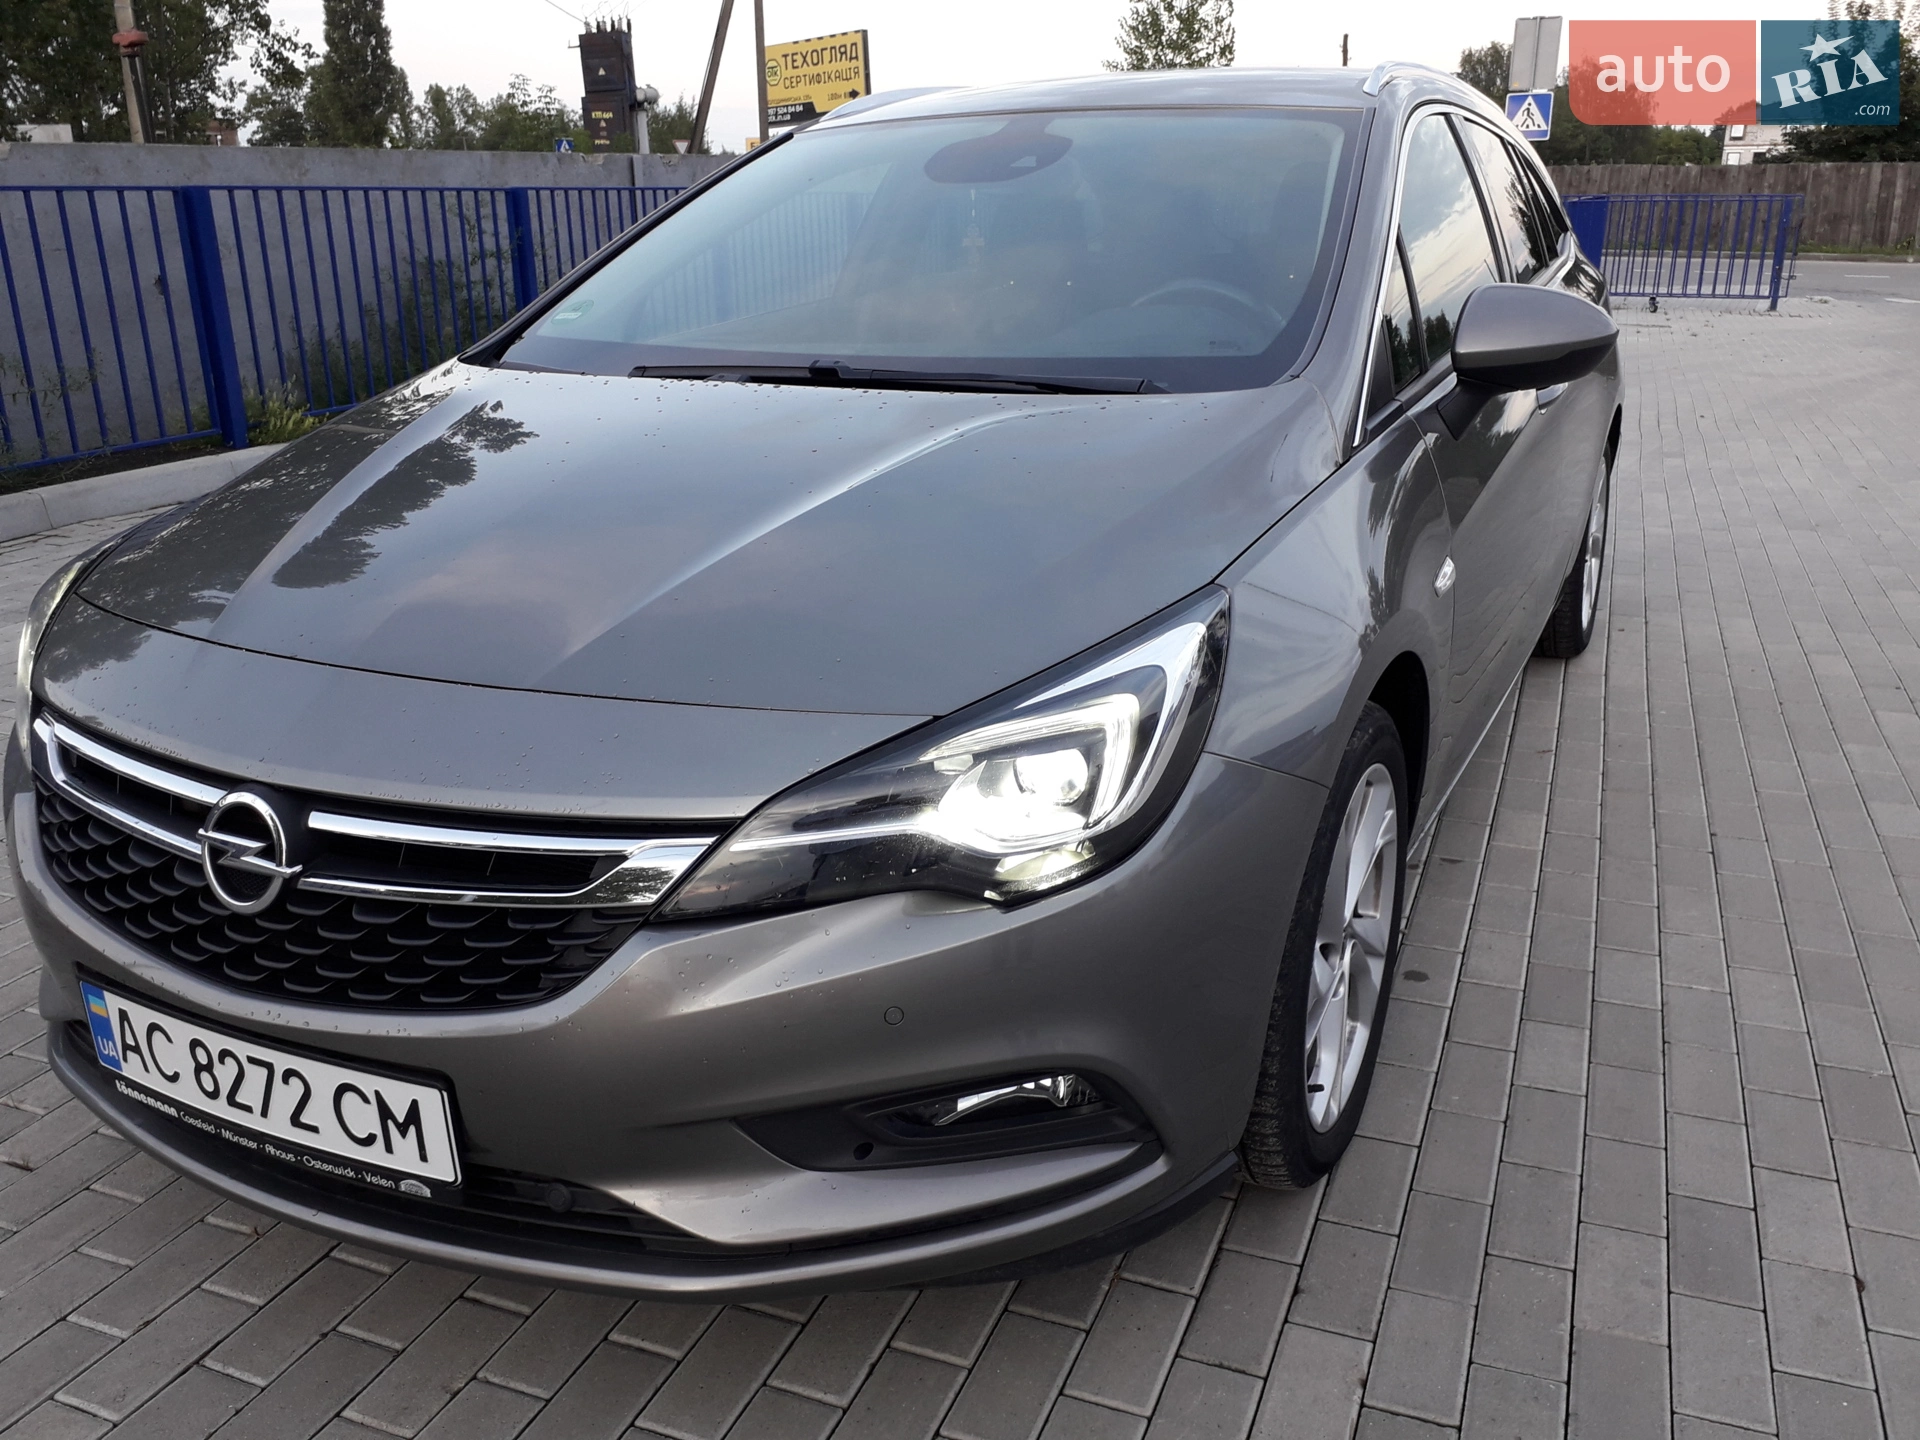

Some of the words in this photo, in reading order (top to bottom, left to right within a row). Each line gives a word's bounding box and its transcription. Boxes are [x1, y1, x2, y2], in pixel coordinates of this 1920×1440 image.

[781, 42, 859, 71] ТЕХОГЛЯД
[783, 66, 860, 90] СЕРТИФІКАЦІЯ
[97, 1036, 119, 1061] UA
[118, 1007, 180, 1084] AC
[189, 1037, 320, 1134] 8272
[333, 1082, 428, 1163] CM
[115, 1079, 179, 1118] tönnemann
[221, 1128, 258, 1150] Münster
[303, 1155, 356, 1178] Osterwick
[362, 1170, 396, 1189] Velen
